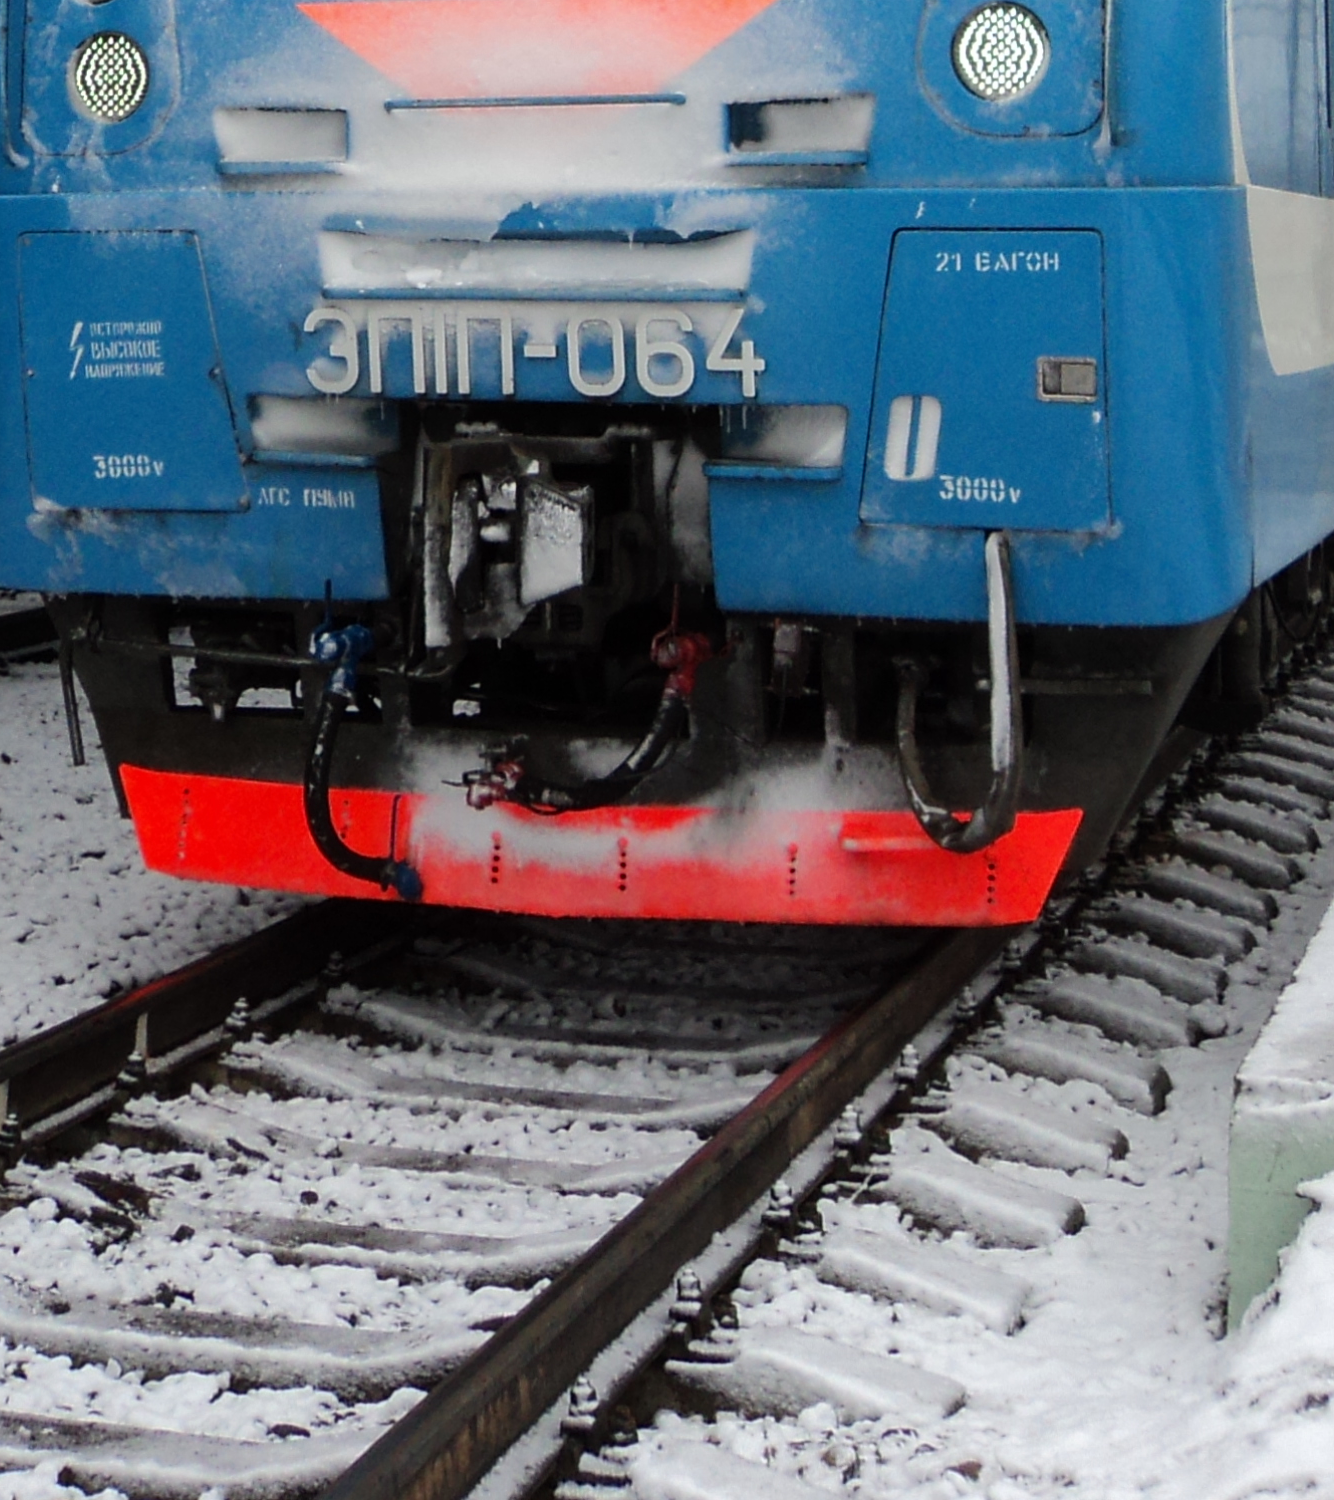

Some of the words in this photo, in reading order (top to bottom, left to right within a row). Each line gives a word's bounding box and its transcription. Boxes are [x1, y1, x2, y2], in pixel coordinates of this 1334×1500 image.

[935, 251, 962, 273] 21
[90, 340, 162, 360] ВЫСОКОЕ
[84, 362, 166, 379] НАПРЯЖЕНИЕ
